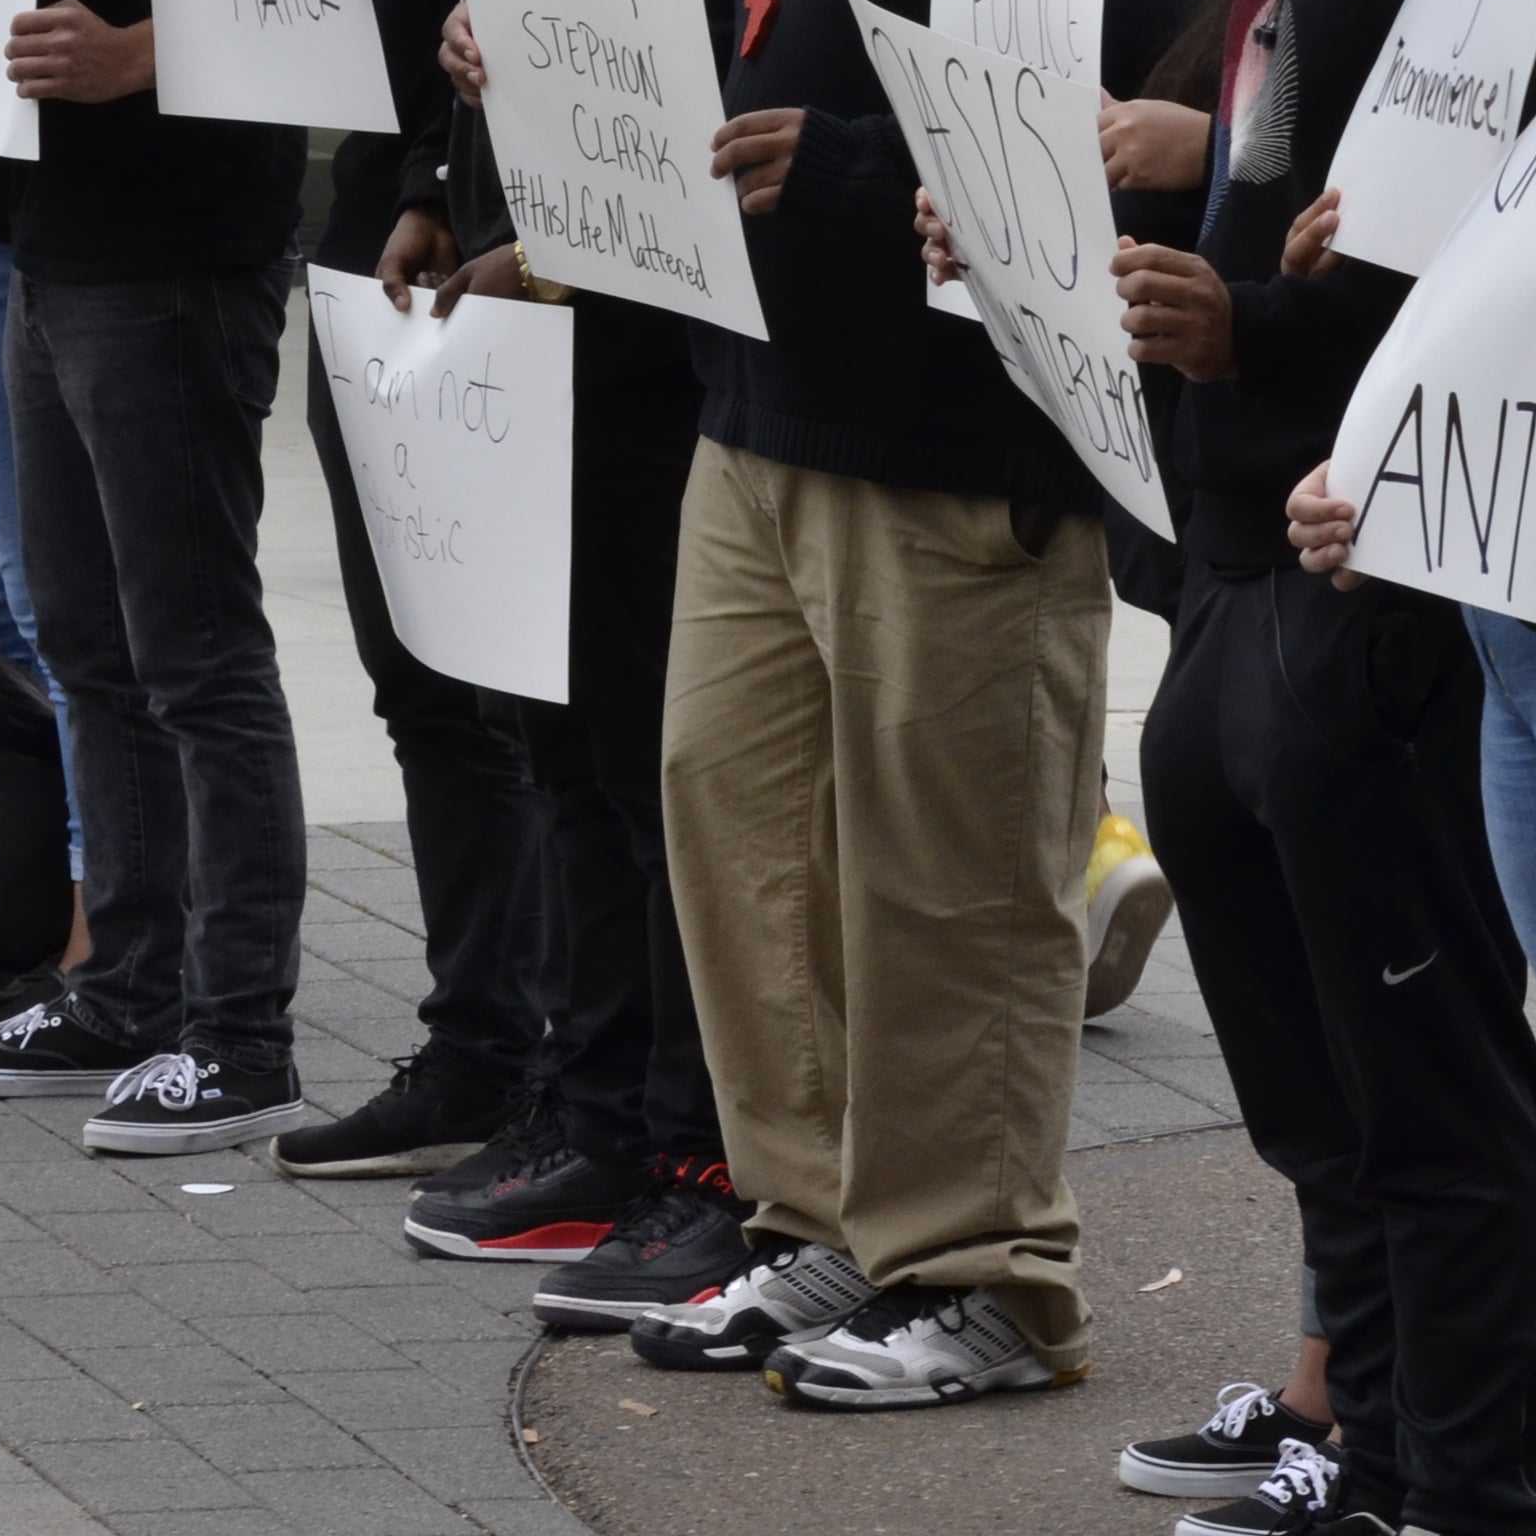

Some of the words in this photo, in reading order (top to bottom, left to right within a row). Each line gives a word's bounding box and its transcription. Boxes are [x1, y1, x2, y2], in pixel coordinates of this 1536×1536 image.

[521, 10, 664, 108] STEPHON
[571, 105, 688, 199] CLARK
[870, 25, 1078, 292] OASIS
[439, 350, 509, 444] not
[394, 441, 416, 489] a
